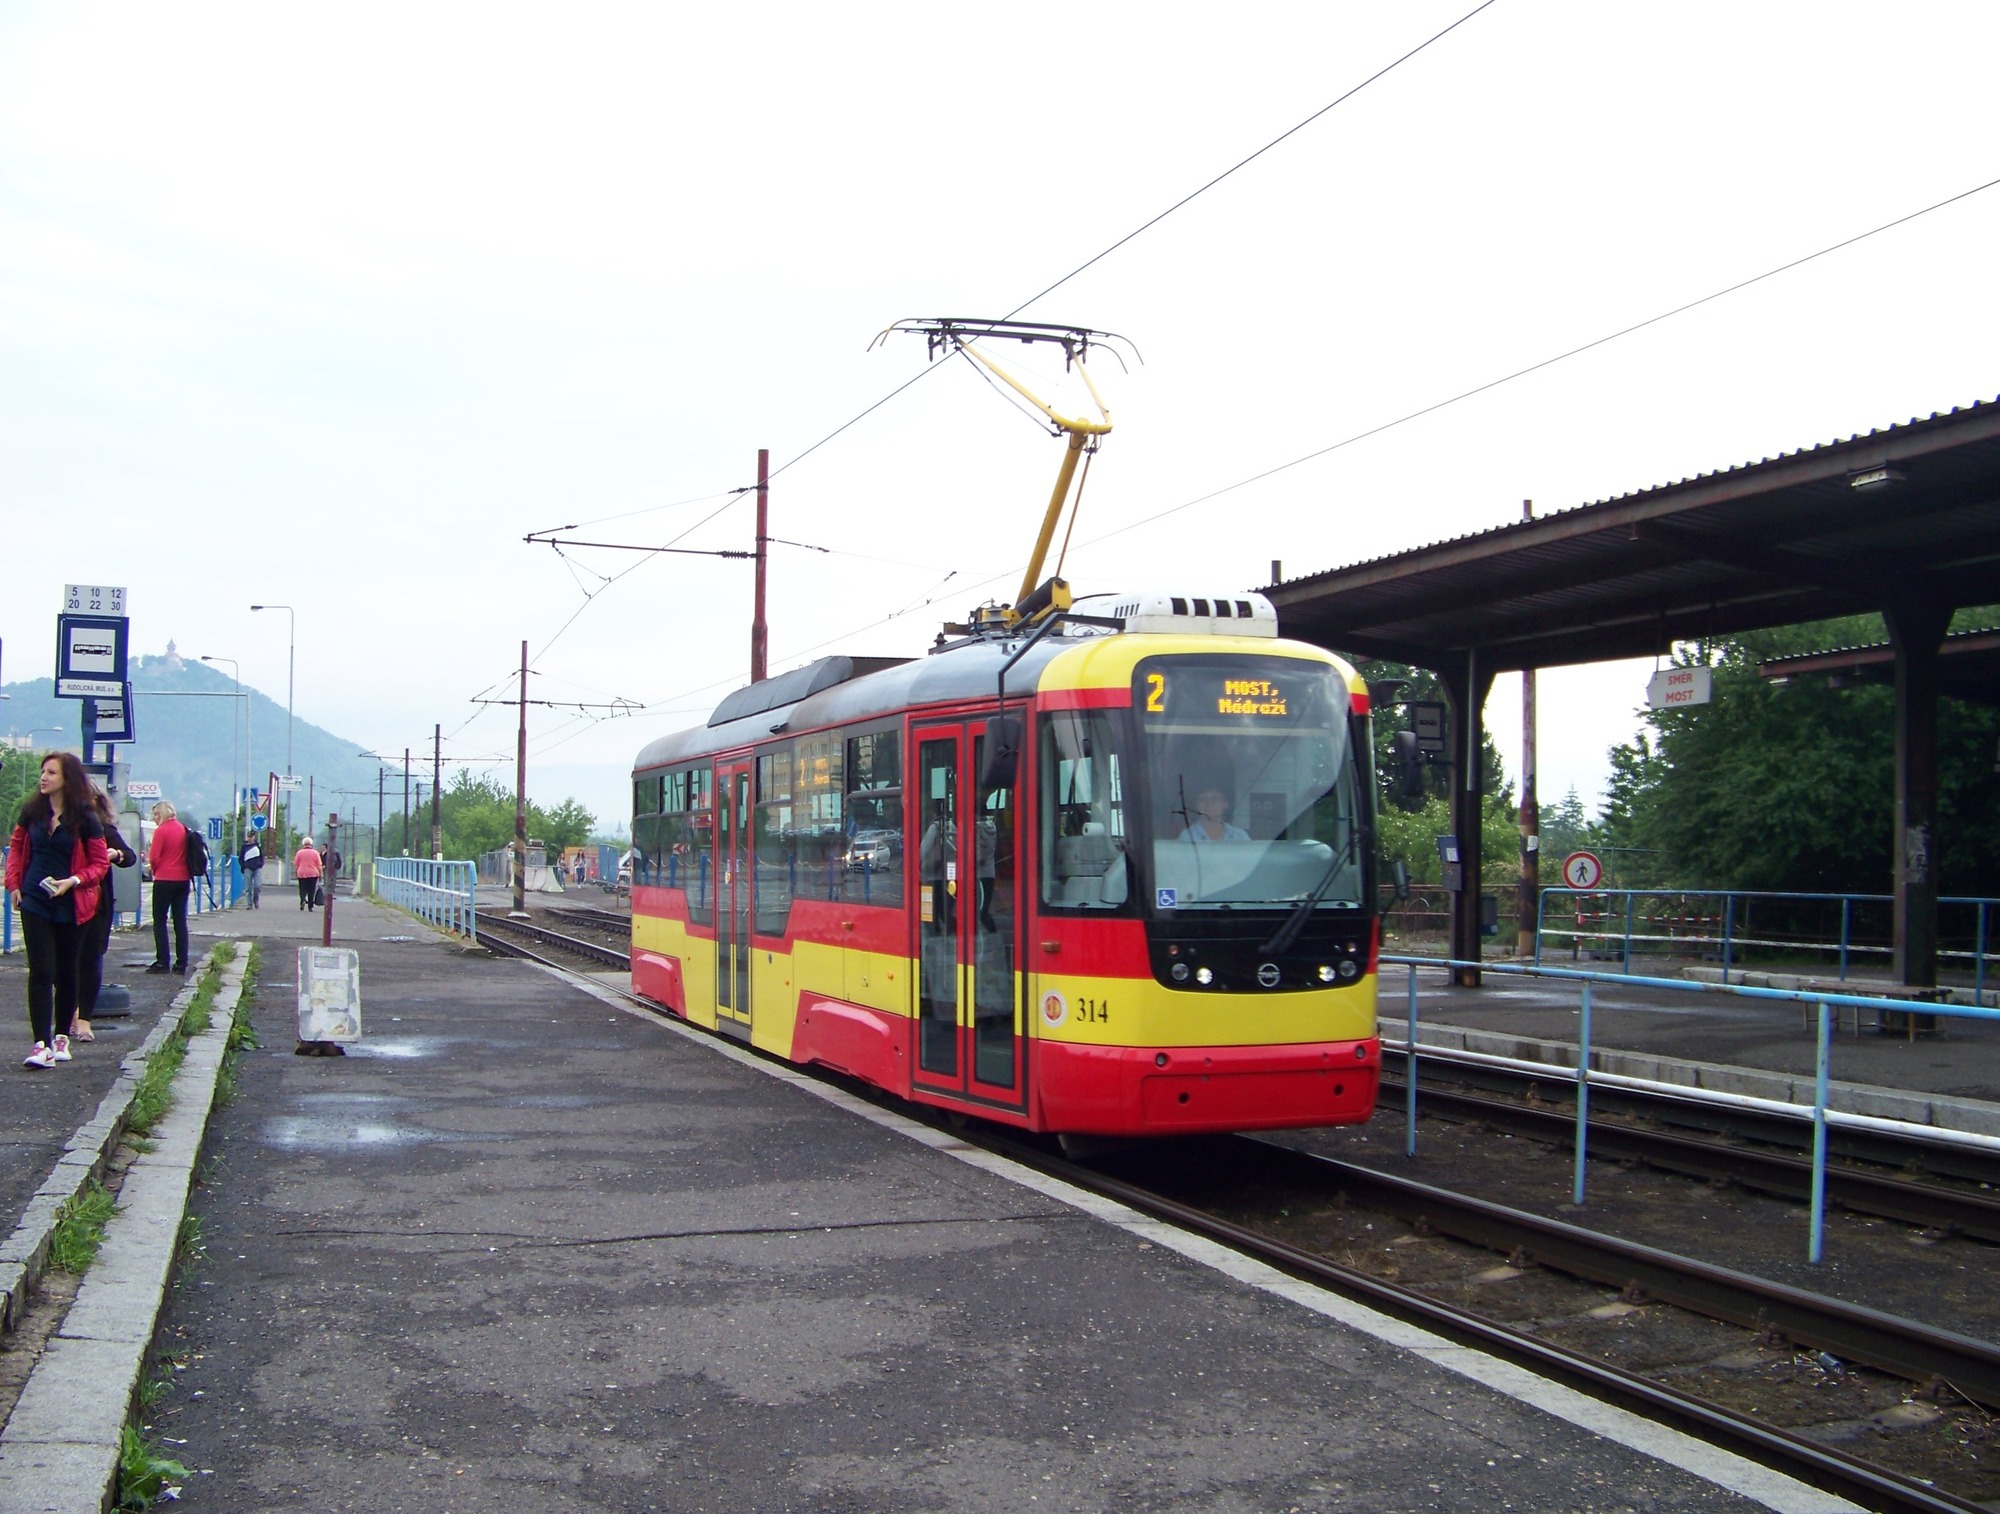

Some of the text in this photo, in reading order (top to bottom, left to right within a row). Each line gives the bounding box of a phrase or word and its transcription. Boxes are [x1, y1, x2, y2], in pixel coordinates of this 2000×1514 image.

[72, 586, 122, 599] 5 10 12
[68, 599, 121, 611] 20 22 30
[1146, 673, 1165, 712] 2
[1225, 680, 1279, 696] MOST,
[1665, 690, 1694, 703] MOST
[1218, 698, 1287, 715] Nádraží
[1077, 997, 1109, 1024] 314
